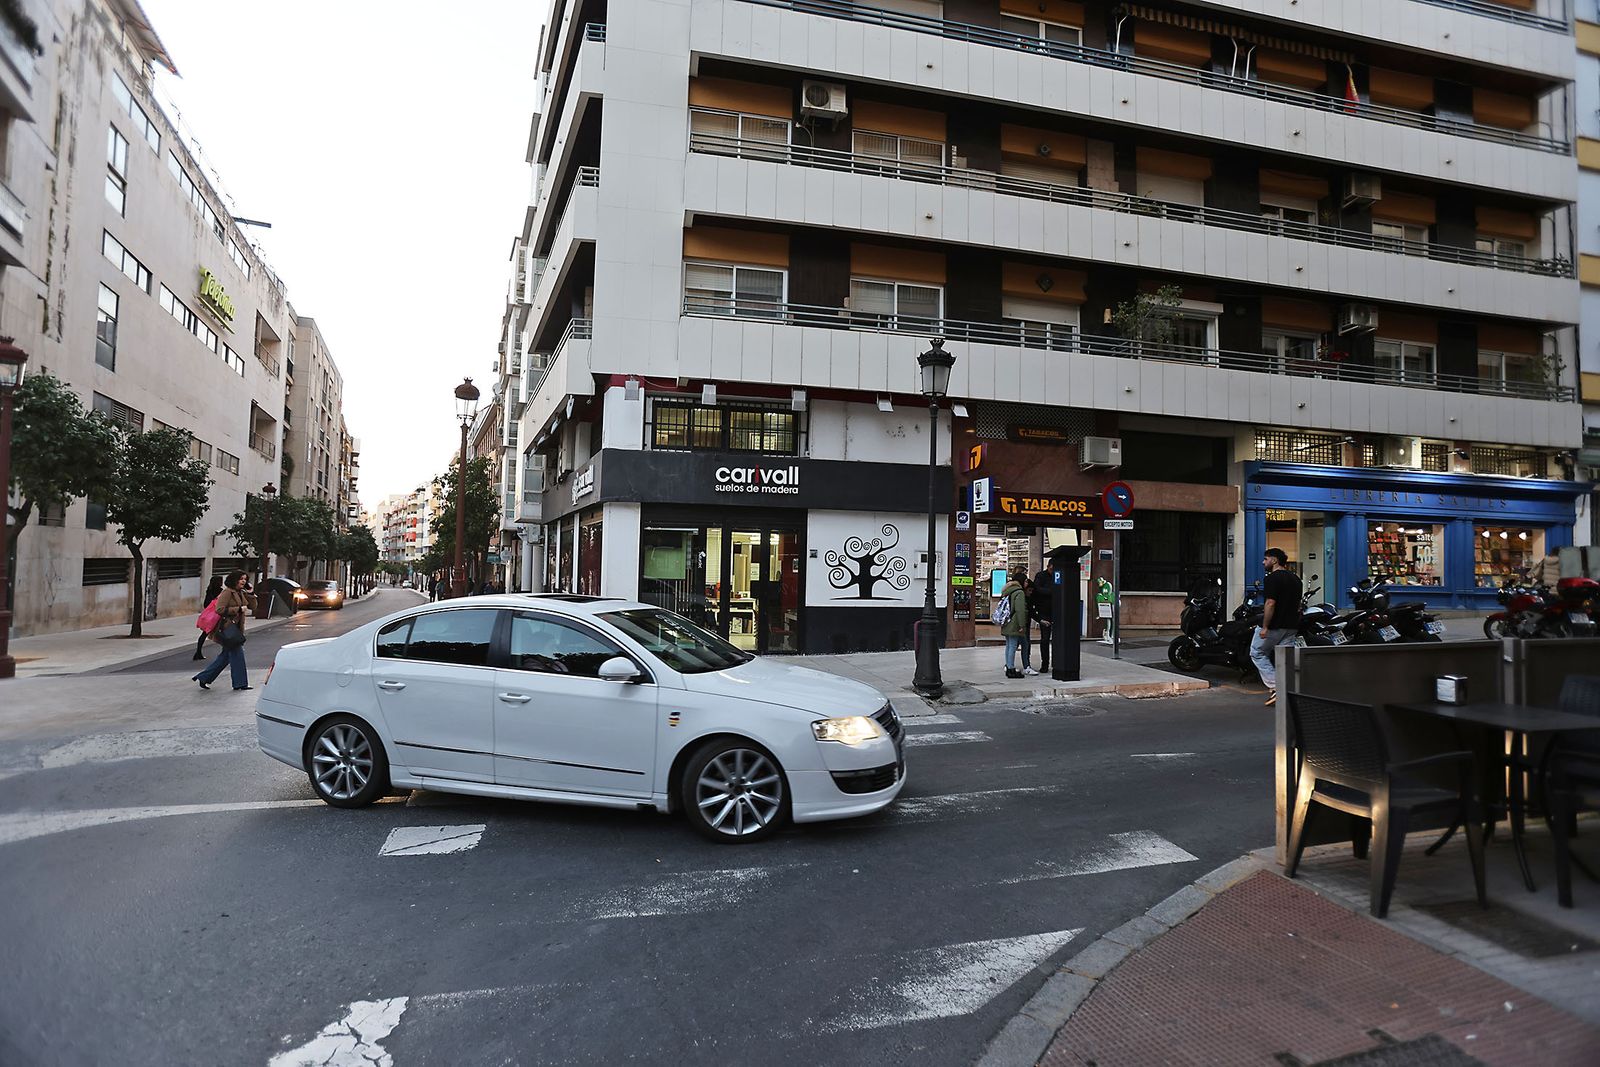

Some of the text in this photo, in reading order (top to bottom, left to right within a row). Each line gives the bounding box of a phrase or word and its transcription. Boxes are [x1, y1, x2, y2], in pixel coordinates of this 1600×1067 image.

[715, 464, 799, 485] carivall
[715, 484, 799, 494] suelos de madera
[1022, 498, 1087, 512] TABACOS
[1054, 571, 1061, 583] P
